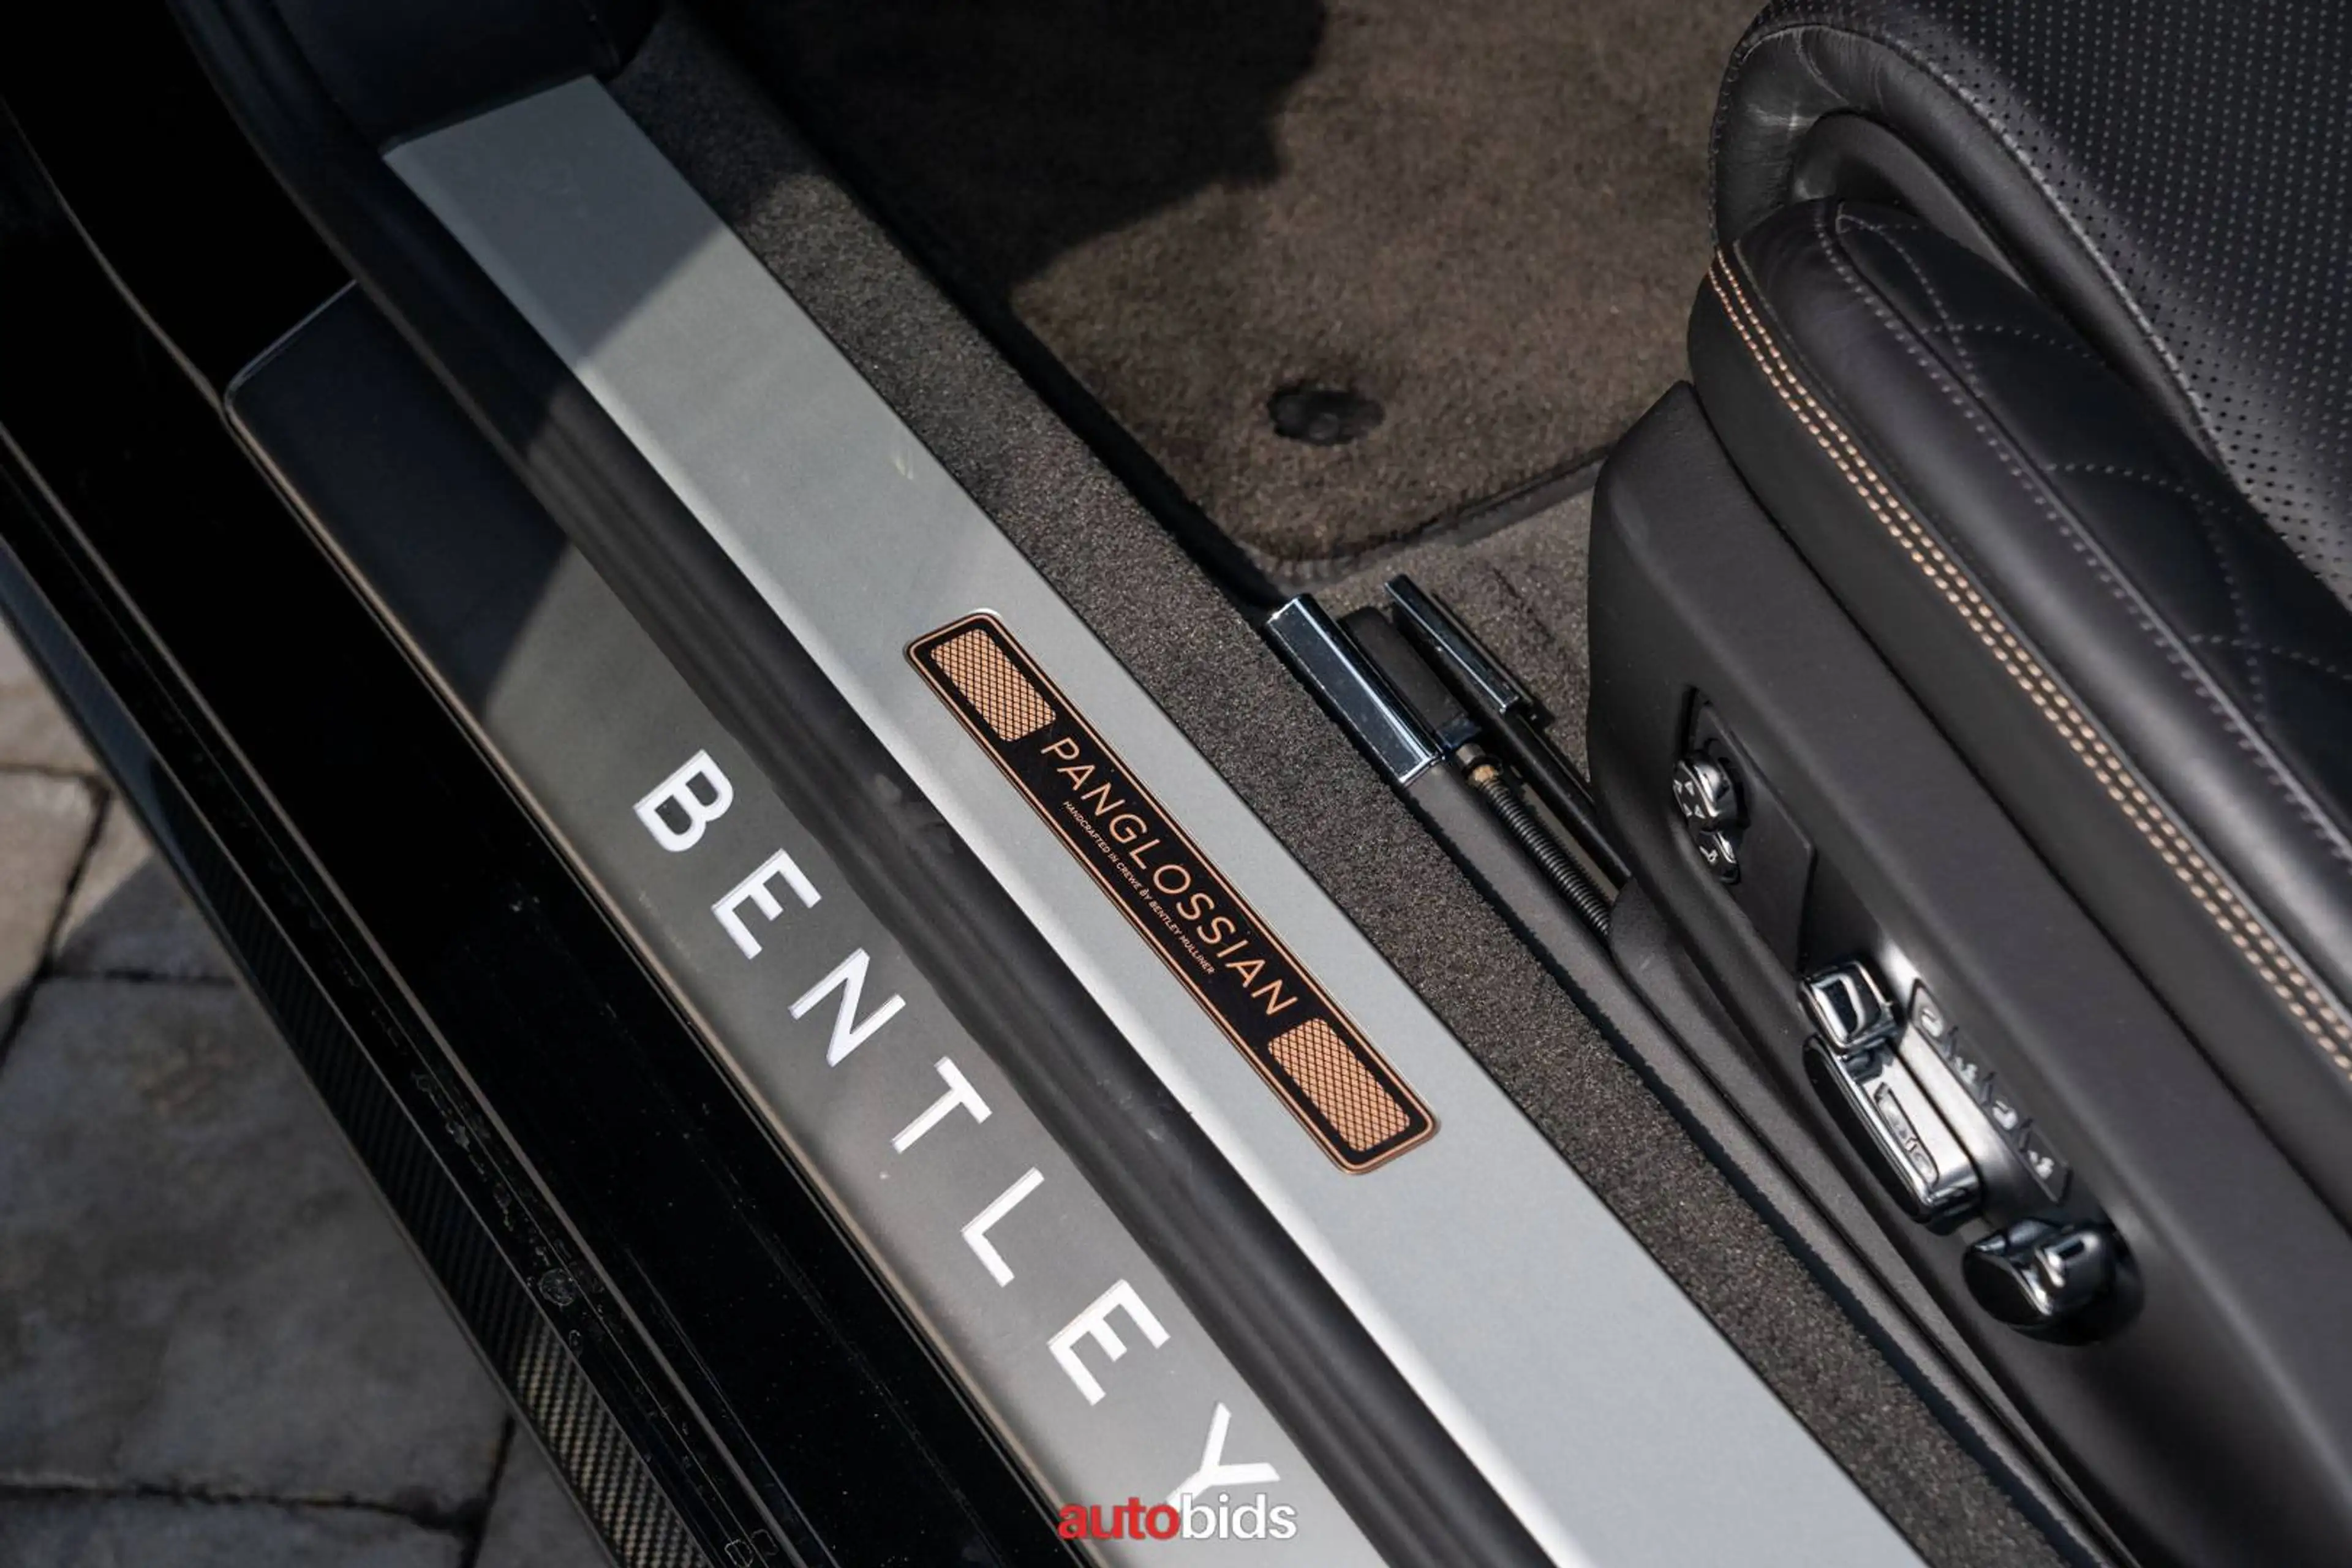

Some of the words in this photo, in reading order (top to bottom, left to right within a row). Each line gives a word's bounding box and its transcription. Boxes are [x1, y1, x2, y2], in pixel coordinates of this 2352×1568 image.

[1042, 738, 1297, 1014] PANGLOSSIAN
[1063, 801, 1110, 853] HANDCRAFTED
[1108, 853, 1120, 862] IN
[1116, 862, 1142, 890] CREWE
[1139, 888, 1152, 900] BY
[1148, 900, 1182, 934] BENTLEY
[1178, 935, 1215, 974] MULLINER
[635, 750, 1280, 1510] BENTLEY
